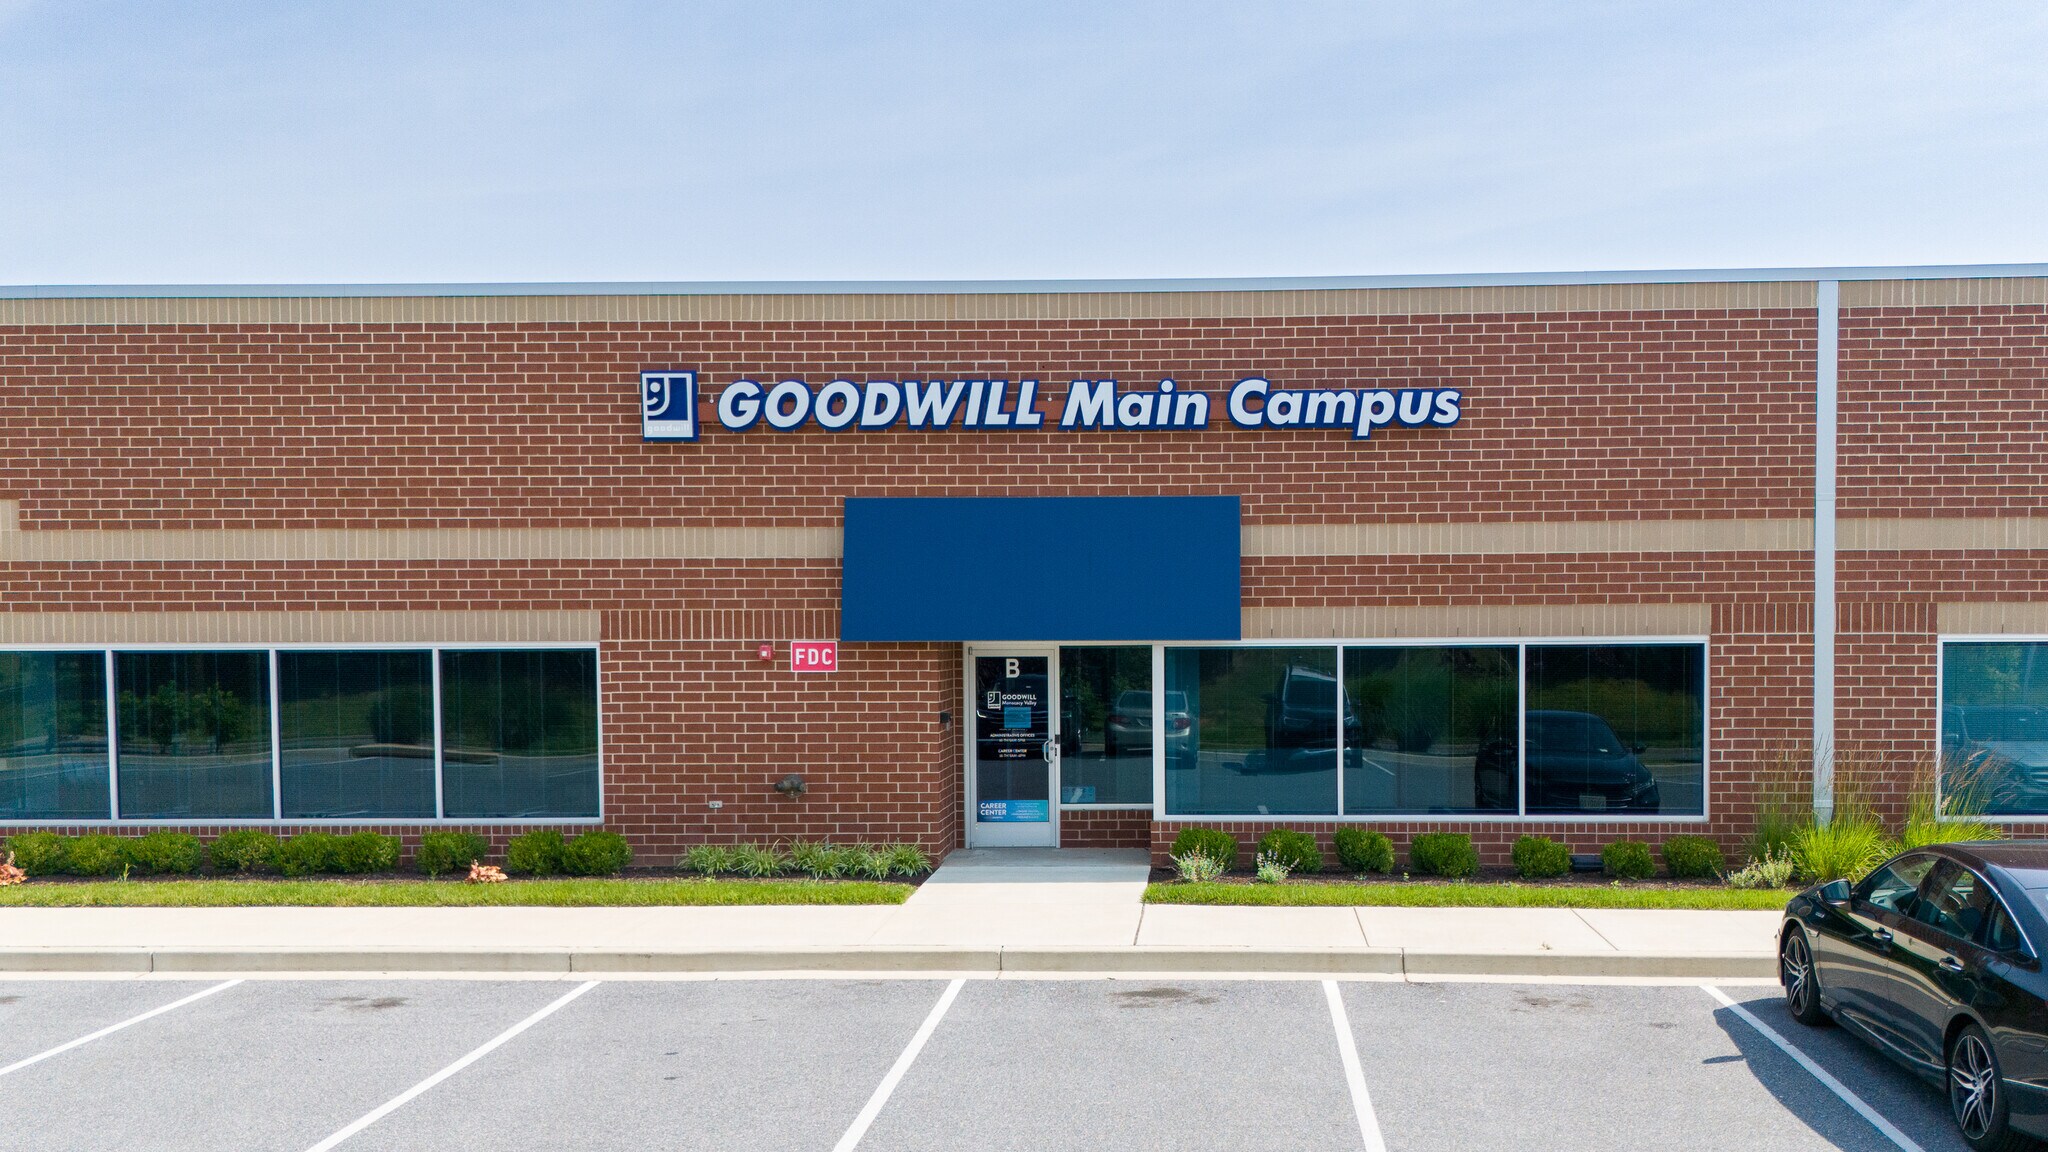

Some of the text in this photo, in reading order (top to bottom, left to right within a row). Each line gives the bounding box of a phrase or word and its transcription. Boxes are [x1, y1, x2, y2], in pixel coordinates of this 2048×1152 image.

[718, 379, 1461, 437] GOODWILL Main Campus
[647, 423, 690, 435] goodwill
[795, 648, 832, 665] FDC
[1006, 658, 1020, 678] B
